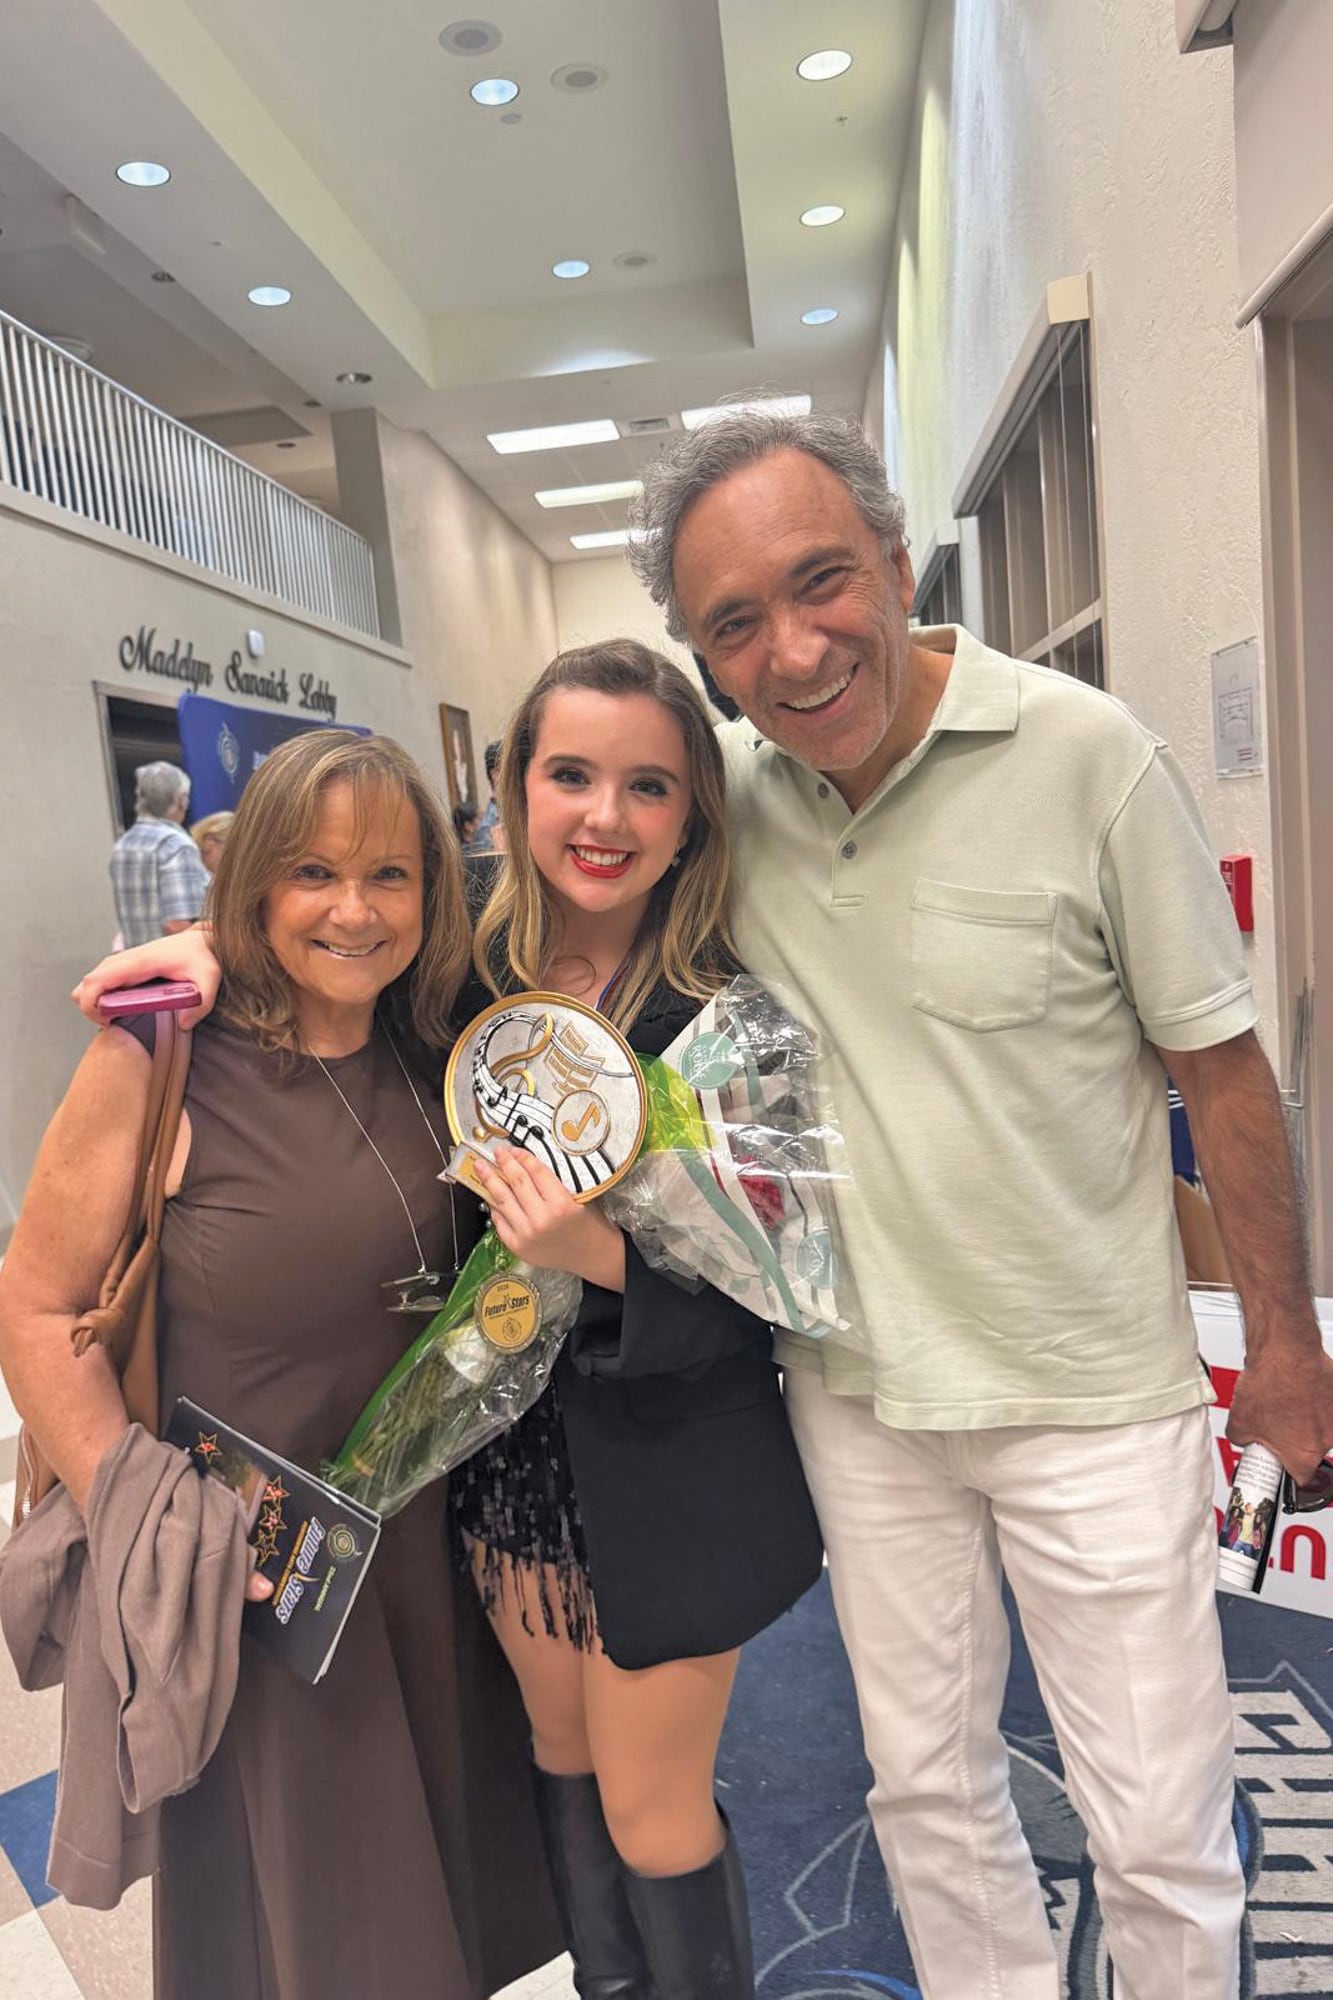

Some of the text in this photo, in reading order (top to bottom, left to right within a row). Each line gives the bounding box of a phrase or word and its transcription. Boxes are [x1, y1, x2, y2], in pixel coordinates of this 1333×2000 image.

[119, 625, 213, 694] Madelyn
[299, 673, 337, 722] Lobby
[485, 1303, 507, 1317] Future
[511, 1295, 529, 1309] Stars
[296, 1516, 326, 1574] Future
[275, 1574, 304, 1624] Stars
